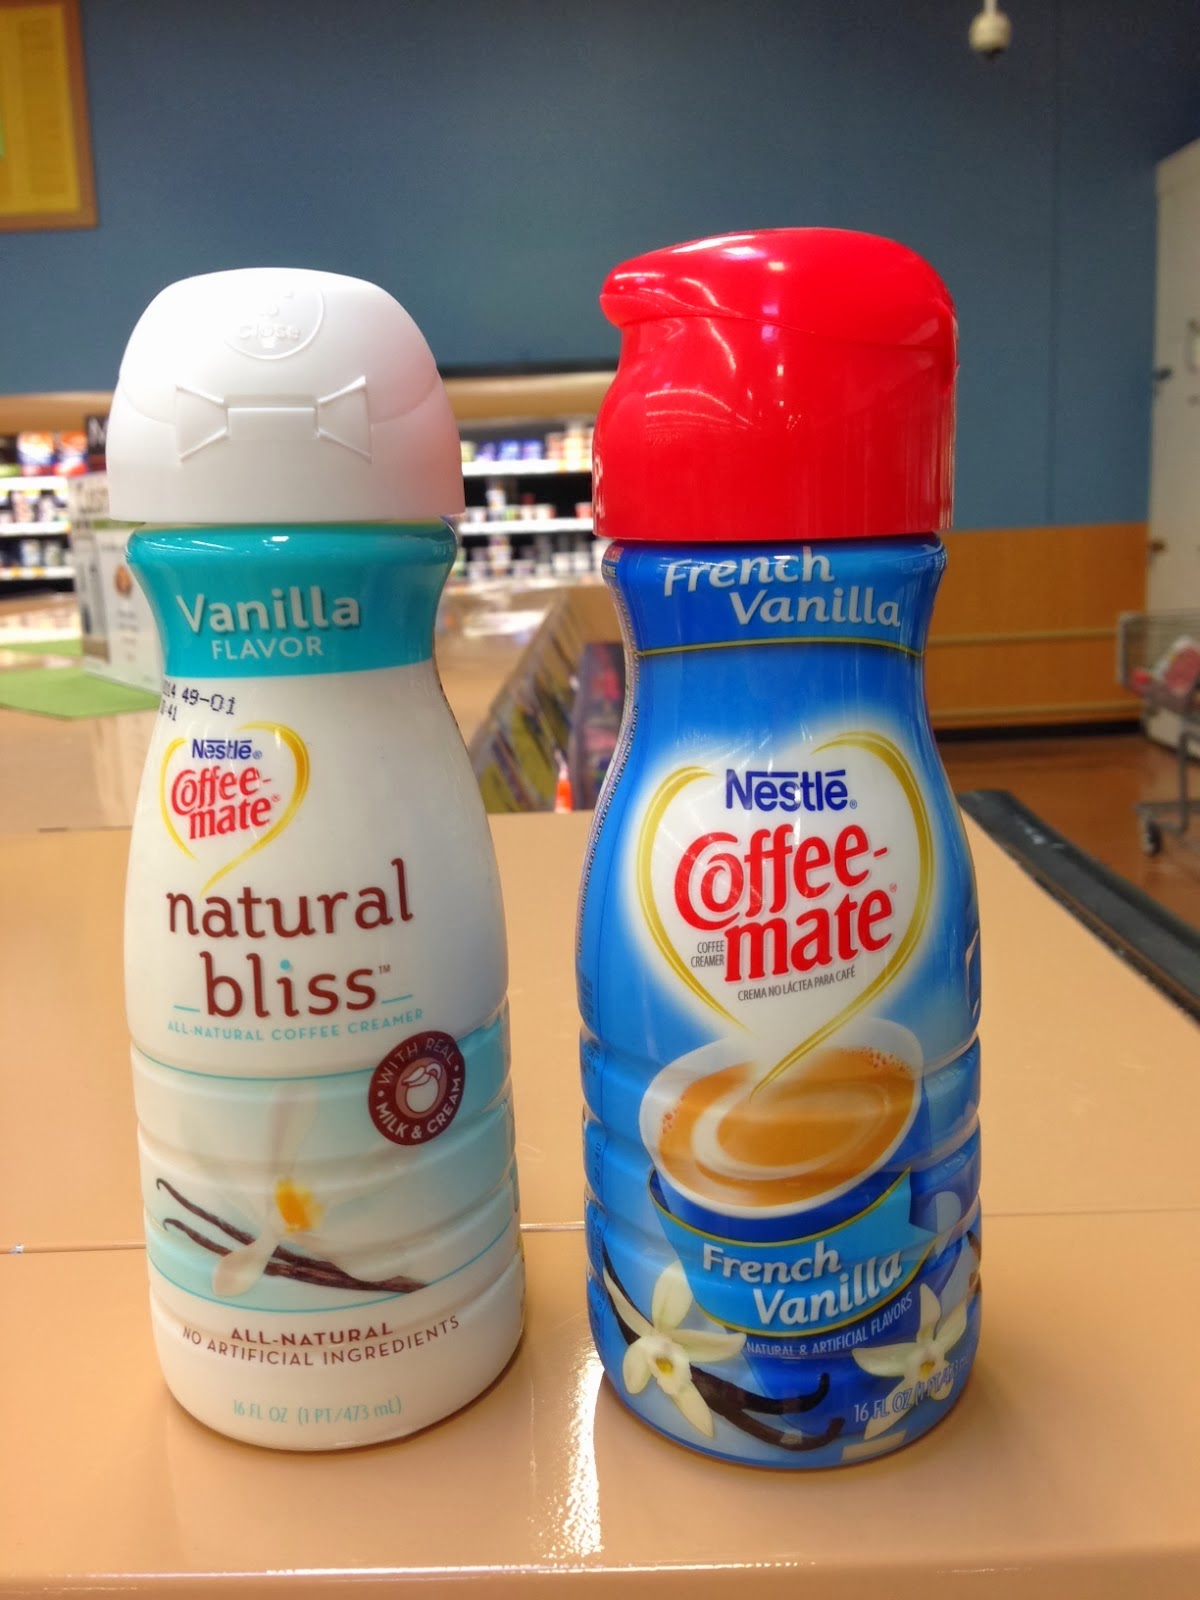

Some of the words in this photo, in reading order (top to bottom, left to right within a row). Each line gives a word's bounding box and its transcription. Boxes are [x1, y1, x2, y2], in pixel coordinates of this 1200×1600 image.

[663, 545, 835, 597] French
[175, 586, 362, 633] Vanilla
[728, 586, 901, 627] Vanilla
[212, 637, 324, 660] FLAVOR
[189, 798, 271, 839] mate
[166, 857, 414, 938] natural
[697, 940, 724, 955] COFFEE
[724, 889, 893, 982] mate
[691, 955, 724, 968] CREAMER
[199, 951, 377, 1018] bliss
[738, 984, 767, 1001] CREMA
[768, 984, 782, 997] NO
[815, 973, 836, 989] PARA
[168, 1020, 264, 1041] ALL-NATURAL
[271, 1025, 340, 1041] COFFEE
[347, 1008, 424, 1034] CREAMER
[377, 1042, 418, 1084] WITH
[425, 1037, 455, 1065] REAL
[376, 1102, 409, 1138] MILK
[411, 1125, 422, 1139] &
[427, 1078, 460, 1133] CREAM
[703, 1240, 841, 1285] French
[753, 1250, 903, 1326] Vanilla
[182, 1326, 202, 1345] NO
[207, 1339, 314, 1366] ARTIFICIAL
[323, 1315, 460, 1365] INGREDIENTS
[230, 1322, 394, 1346] ALL-NATURAL
[746, 1342, 794, 1356] NATURAL
[800, 1345, 808, 1355] &
[812, 1326, 869, 1354] ARTIFICIAL
[871, 1291, 913, 1336] FLAVORS
[233, 1399, 246, 1416] 16
[249, 1402, 262, 1420] FL
[269, 1406, 288, 1423] OZ
[854, 1403, 869, 1423] 16
[873, 1398, 890, 1419] FL
[892, 1387, 913, 1413] OZ
